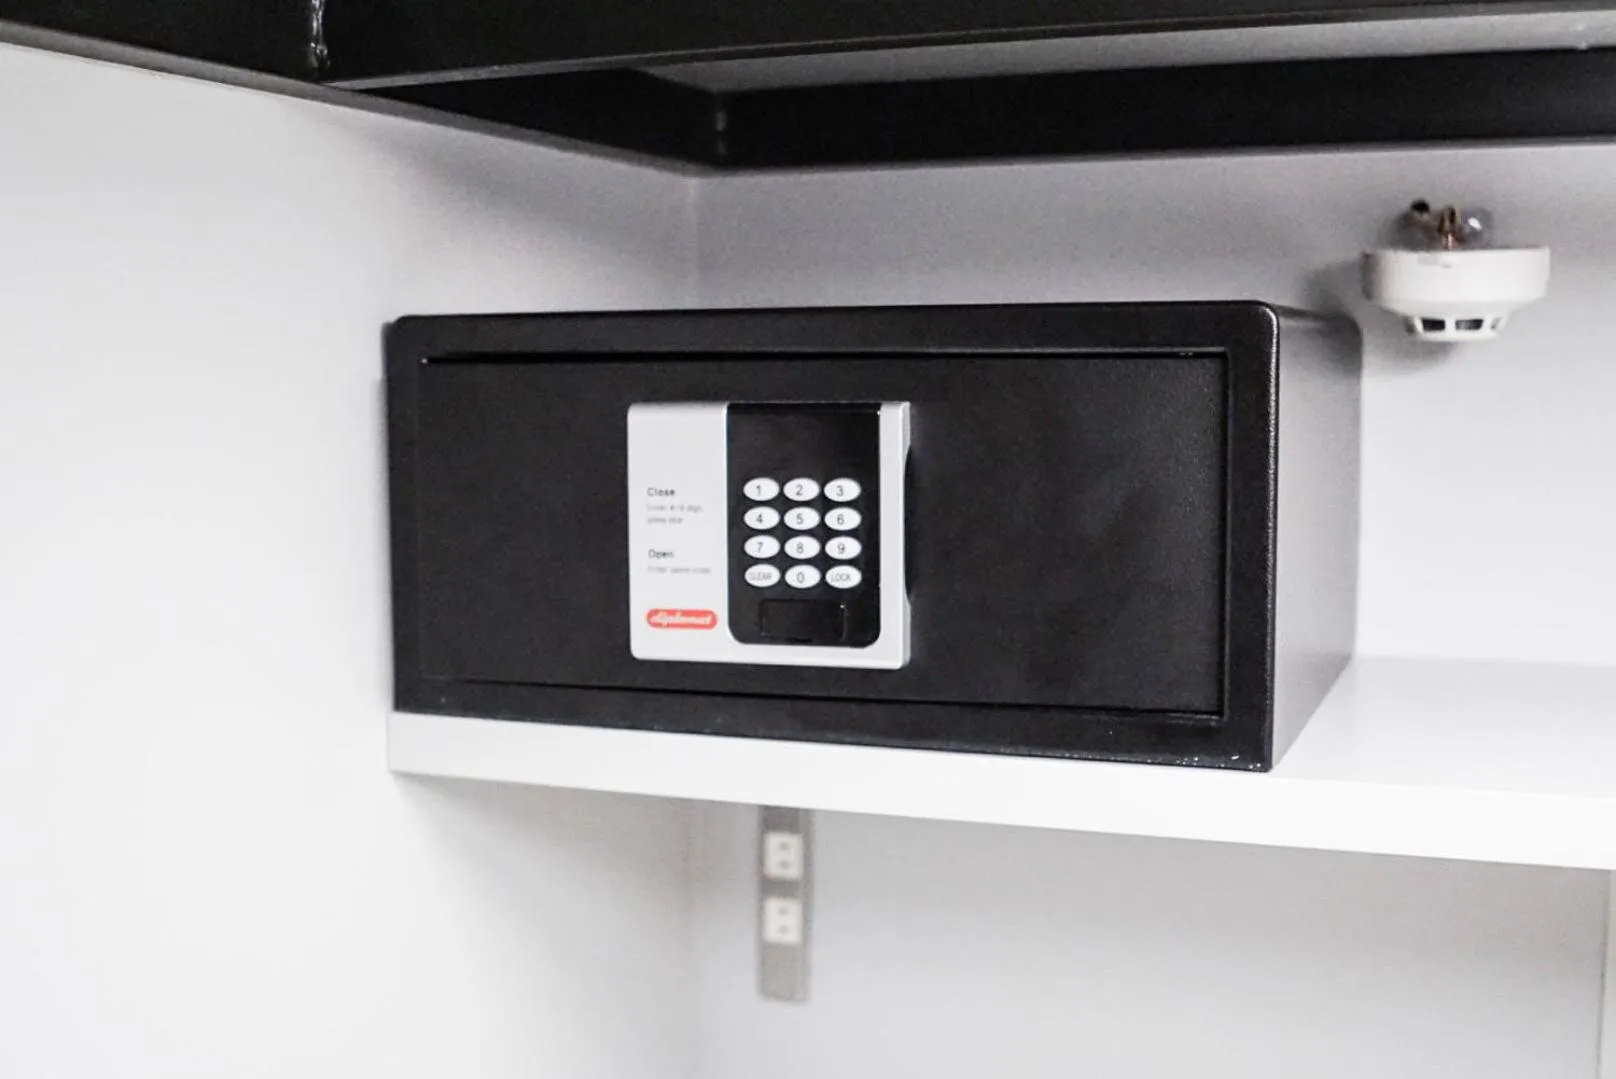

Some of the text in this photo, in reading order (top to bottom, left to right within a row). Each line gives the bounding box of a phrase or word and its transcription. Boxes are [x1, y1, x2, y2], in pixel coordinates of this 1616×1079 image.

[647, 487, 675, 497] Close
[756, 484, 844, 497] 1 2 3
[756, 513, 845, 525] 4 5 6
[648, 548, 674, 559] Open
[756, 541, 845, 554] 7 8 9
[796, 572, 805, 584] 0
[831, 573, 851, 582] LOCK
